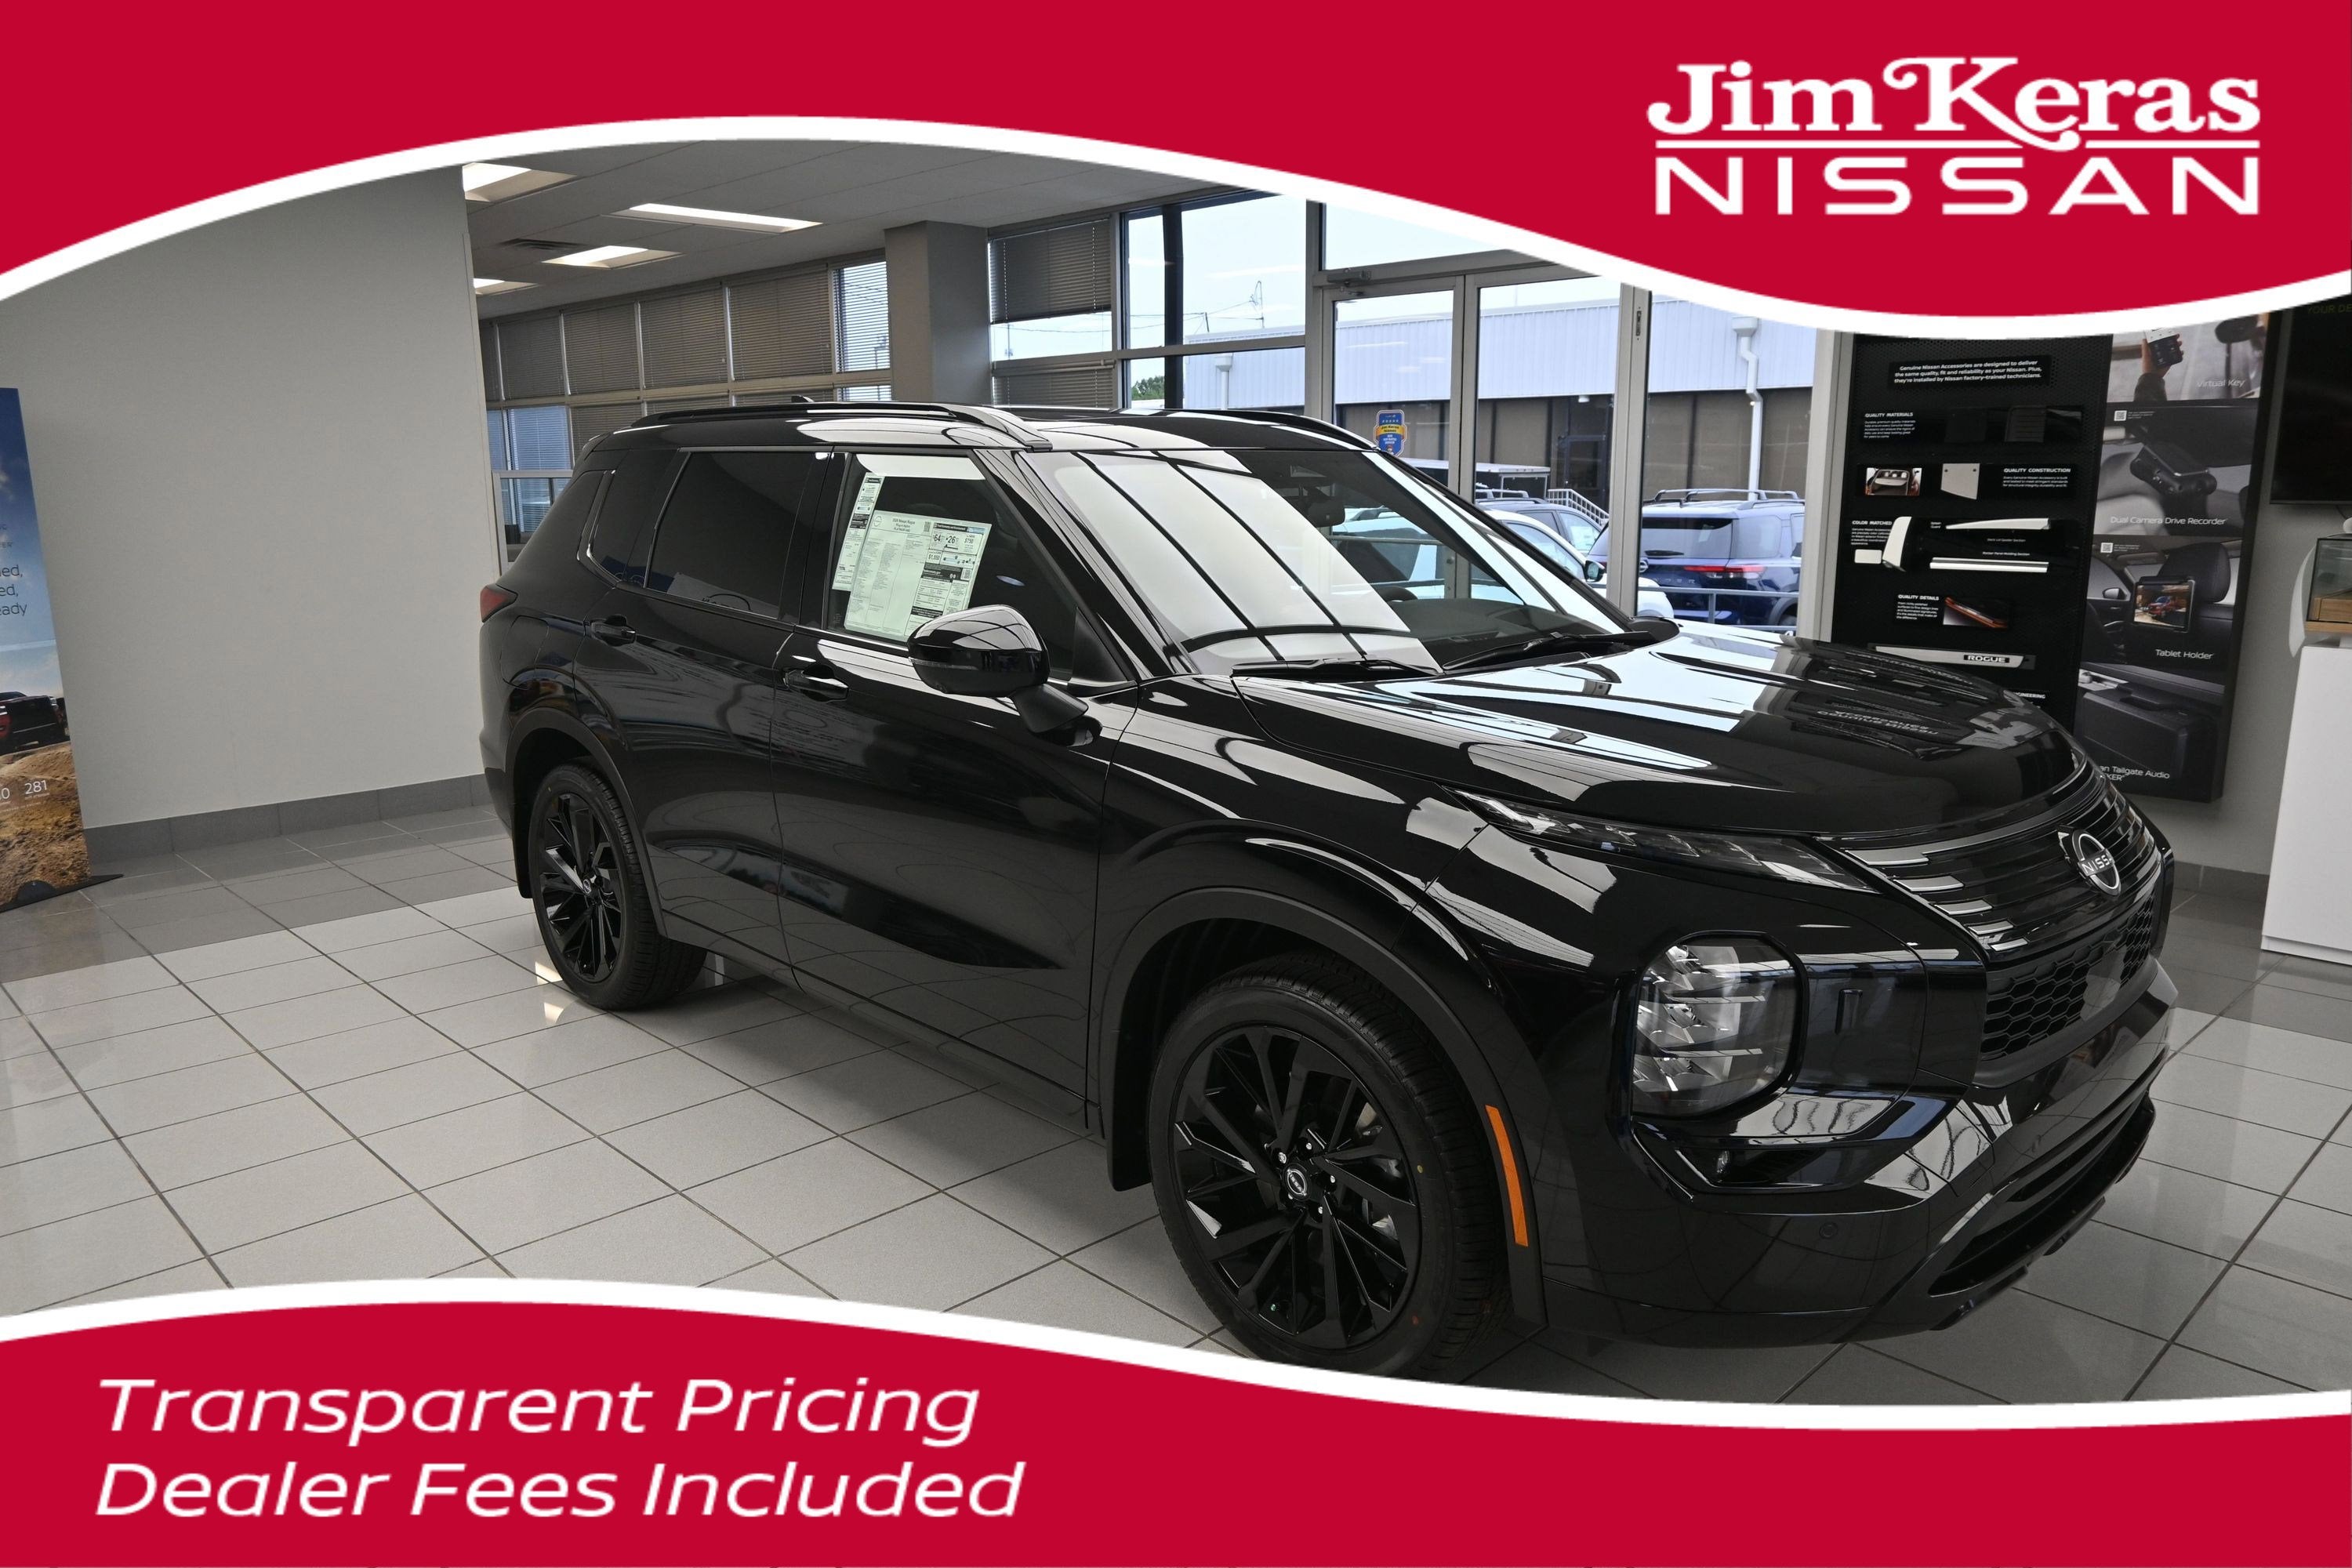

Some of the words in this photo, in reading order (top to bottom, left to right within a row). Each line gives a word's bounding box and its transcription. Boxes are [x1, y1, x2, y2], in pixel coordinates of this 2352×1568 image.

[2228, 379, 2245, 387] Key
[0, 564, 23, 578] ed,
[0, 601, 27, 616] ady
[2112, 766, 2143, 776] Tailgate
[2145, 770, 2170, 779] Audio
[0, 787, 9, 800] 0
[24, 779, 47, 795] 281
[2082, 854, 2113, 874] NISS
